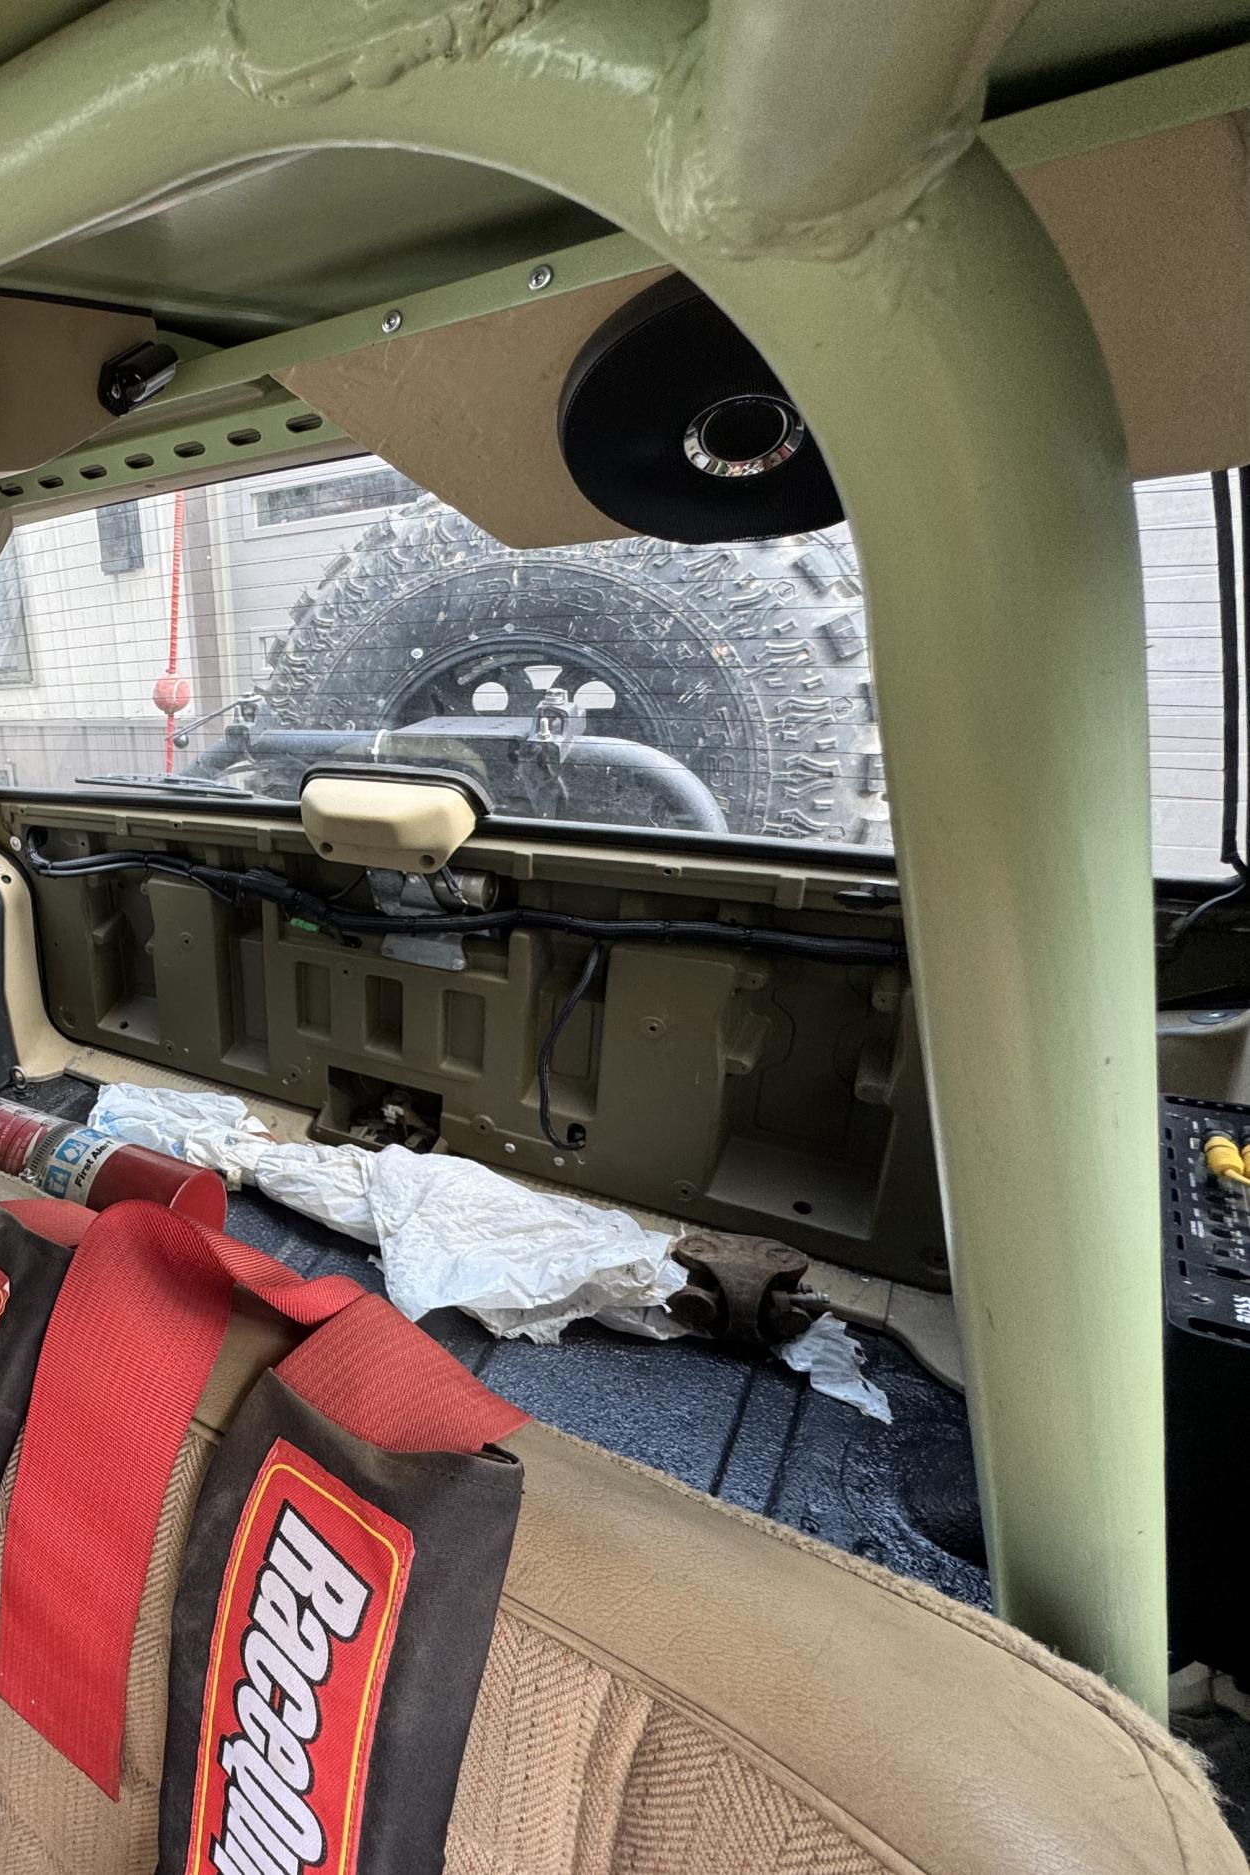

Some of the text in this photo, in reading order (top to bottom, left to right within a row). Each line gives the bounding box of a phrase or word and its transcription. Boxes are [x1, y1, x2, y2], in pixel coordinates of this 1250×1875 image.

[74, 1158, 94, 1188] First
[91, 1140, 115, 1160] Alert
[209, 1498, 375, 1875] RaceQu
